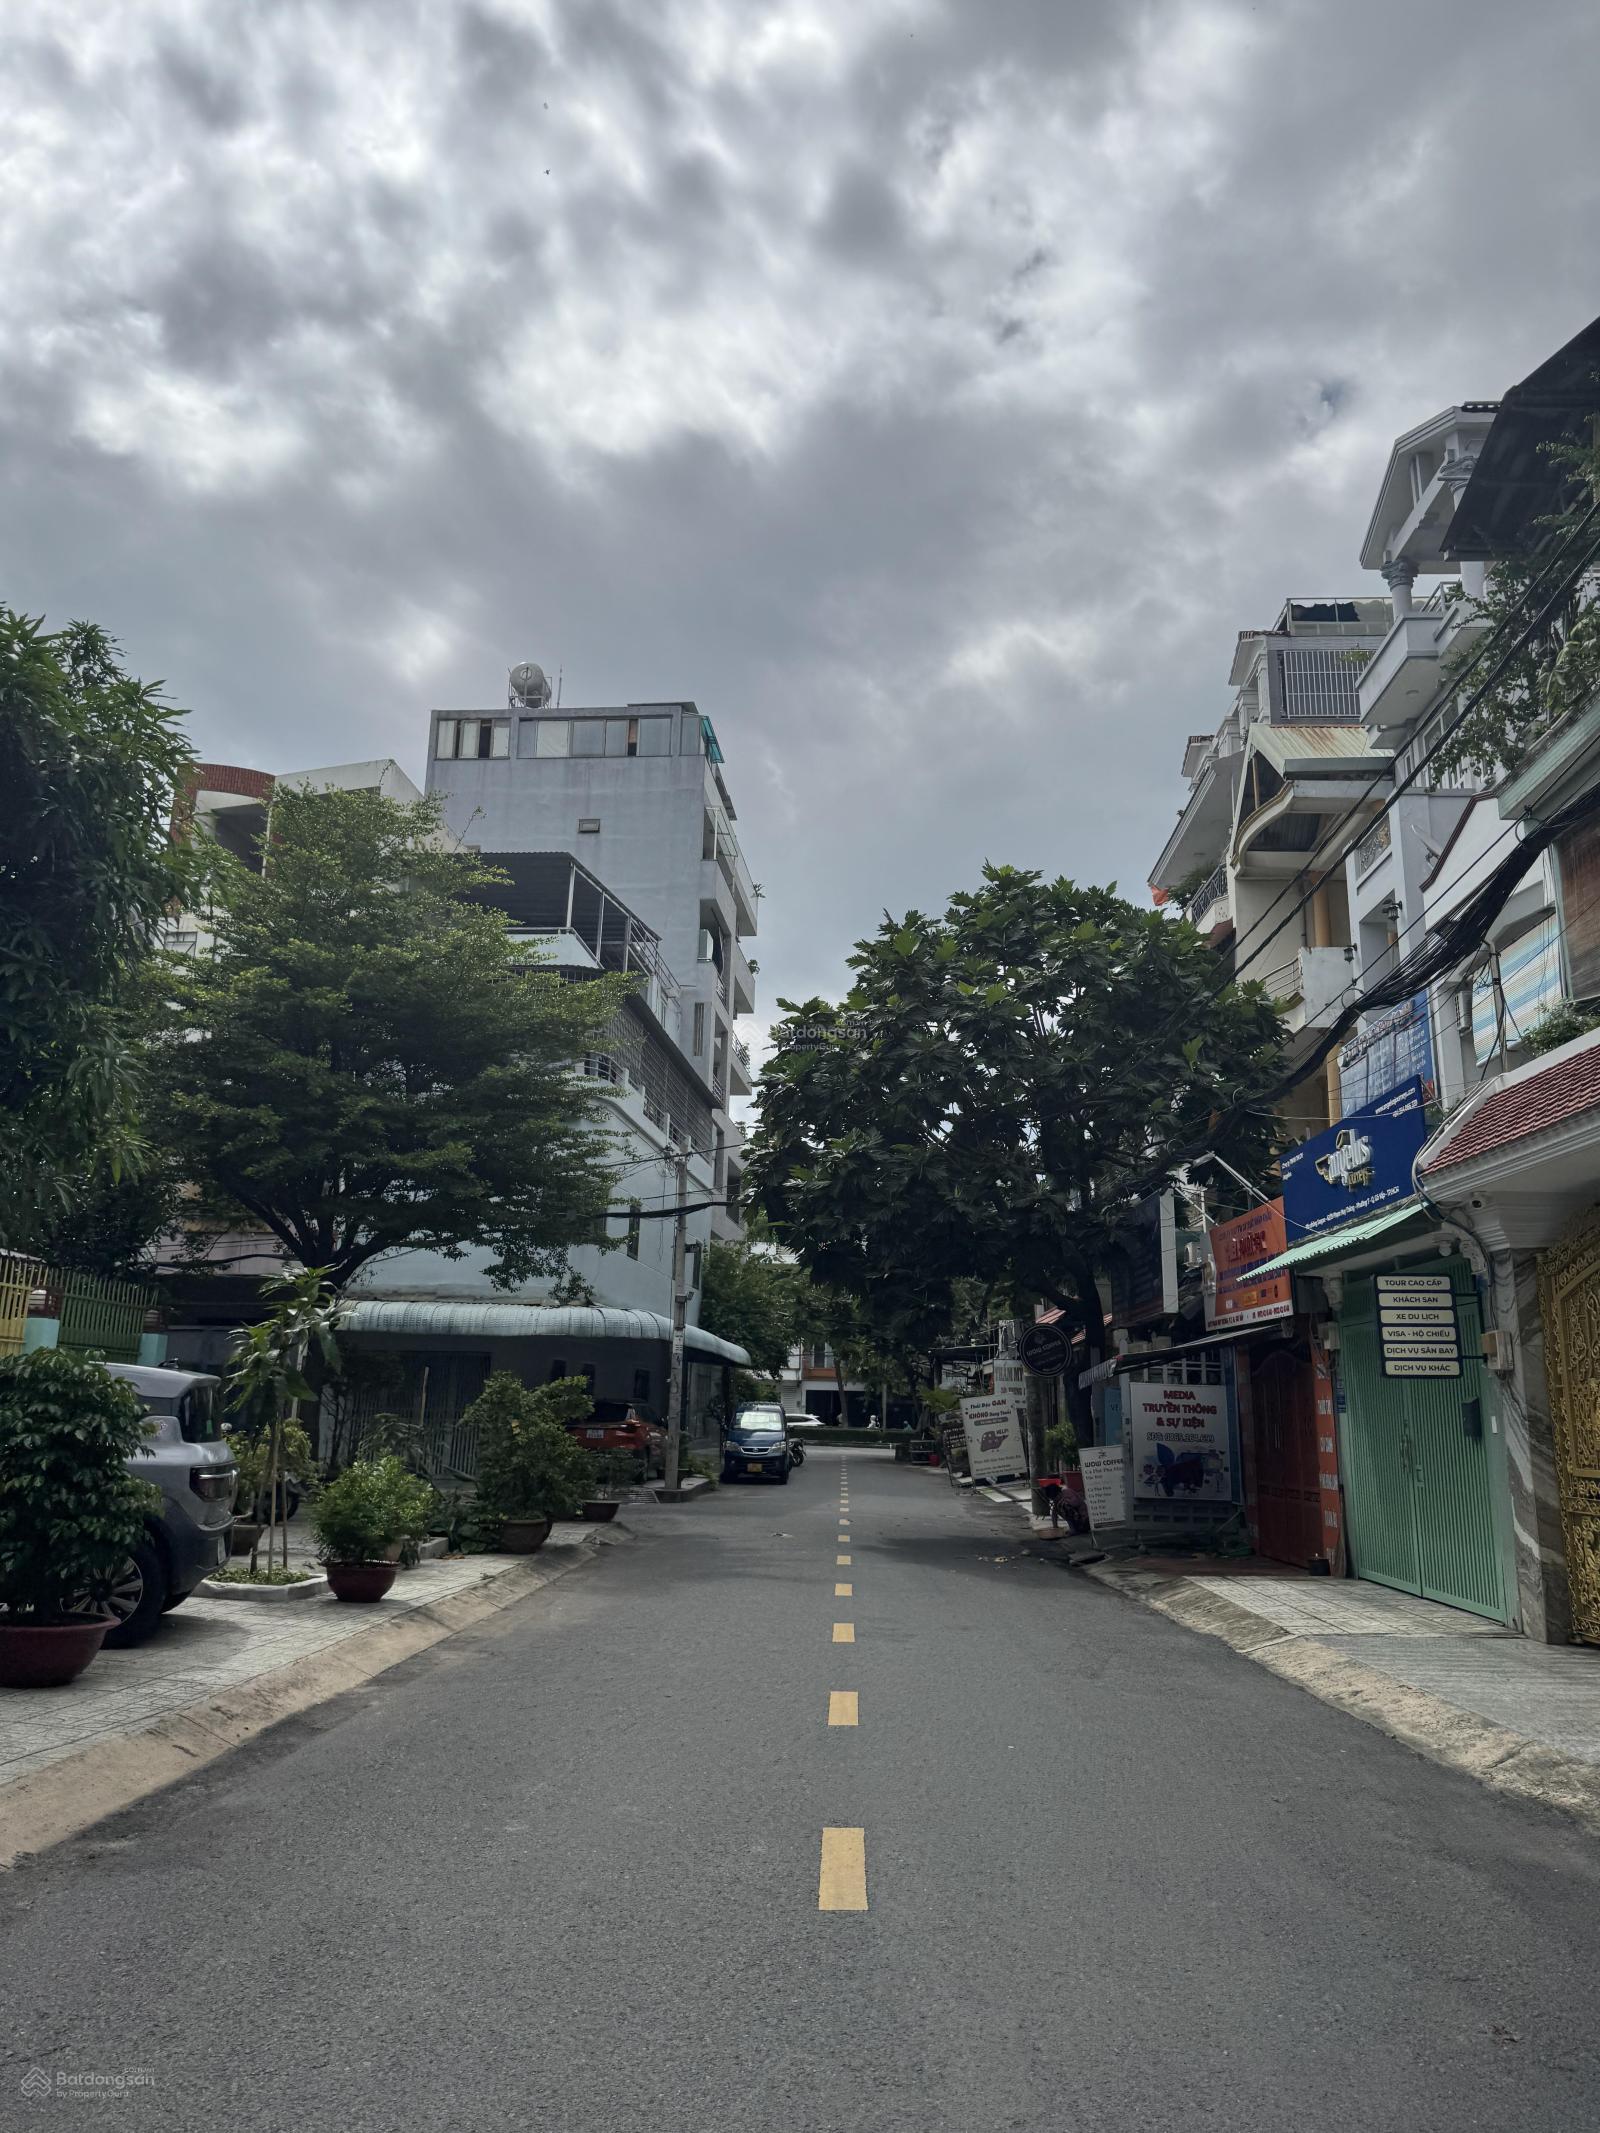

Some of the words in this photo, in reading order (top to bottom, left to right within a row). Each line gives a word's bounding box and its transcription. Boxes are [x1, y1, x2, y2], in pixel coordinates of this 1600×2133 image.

[1427, 1277, 1442, 1286] CẤP
[1393, 1295, 1420, 1303] KHÁCH
[1422, 1296, 1438, 1304] SẠN
[1422, 1313, 1440, 1321] LỊCH
[1426, 1328, 1450, 1337] CHIẾU
[1387, 1347, 1406, 1355] DỊCH
[1408, 1347, 1419, 1355] VỤ
[1421, 1346, 1437, 1354] SÂN
[1394, 1364, 1414, 1372] DỊCH
[1416, 1364, 1427, 1372] VỤ
[1429, 1362, 1451, 1371] KHÁC
[1163, 1390, 1196, 1400] MEDIA
[1142, 1401, 1180, 1413] TRUYỀN
[1182, 1403, 1217, 1415] THÔNG
[1156, 1417, 1165, 1427] &
[1166, 1417, 1181, 1429] SỰ
[1182, 1416, 1205, 1429] KIỆN
